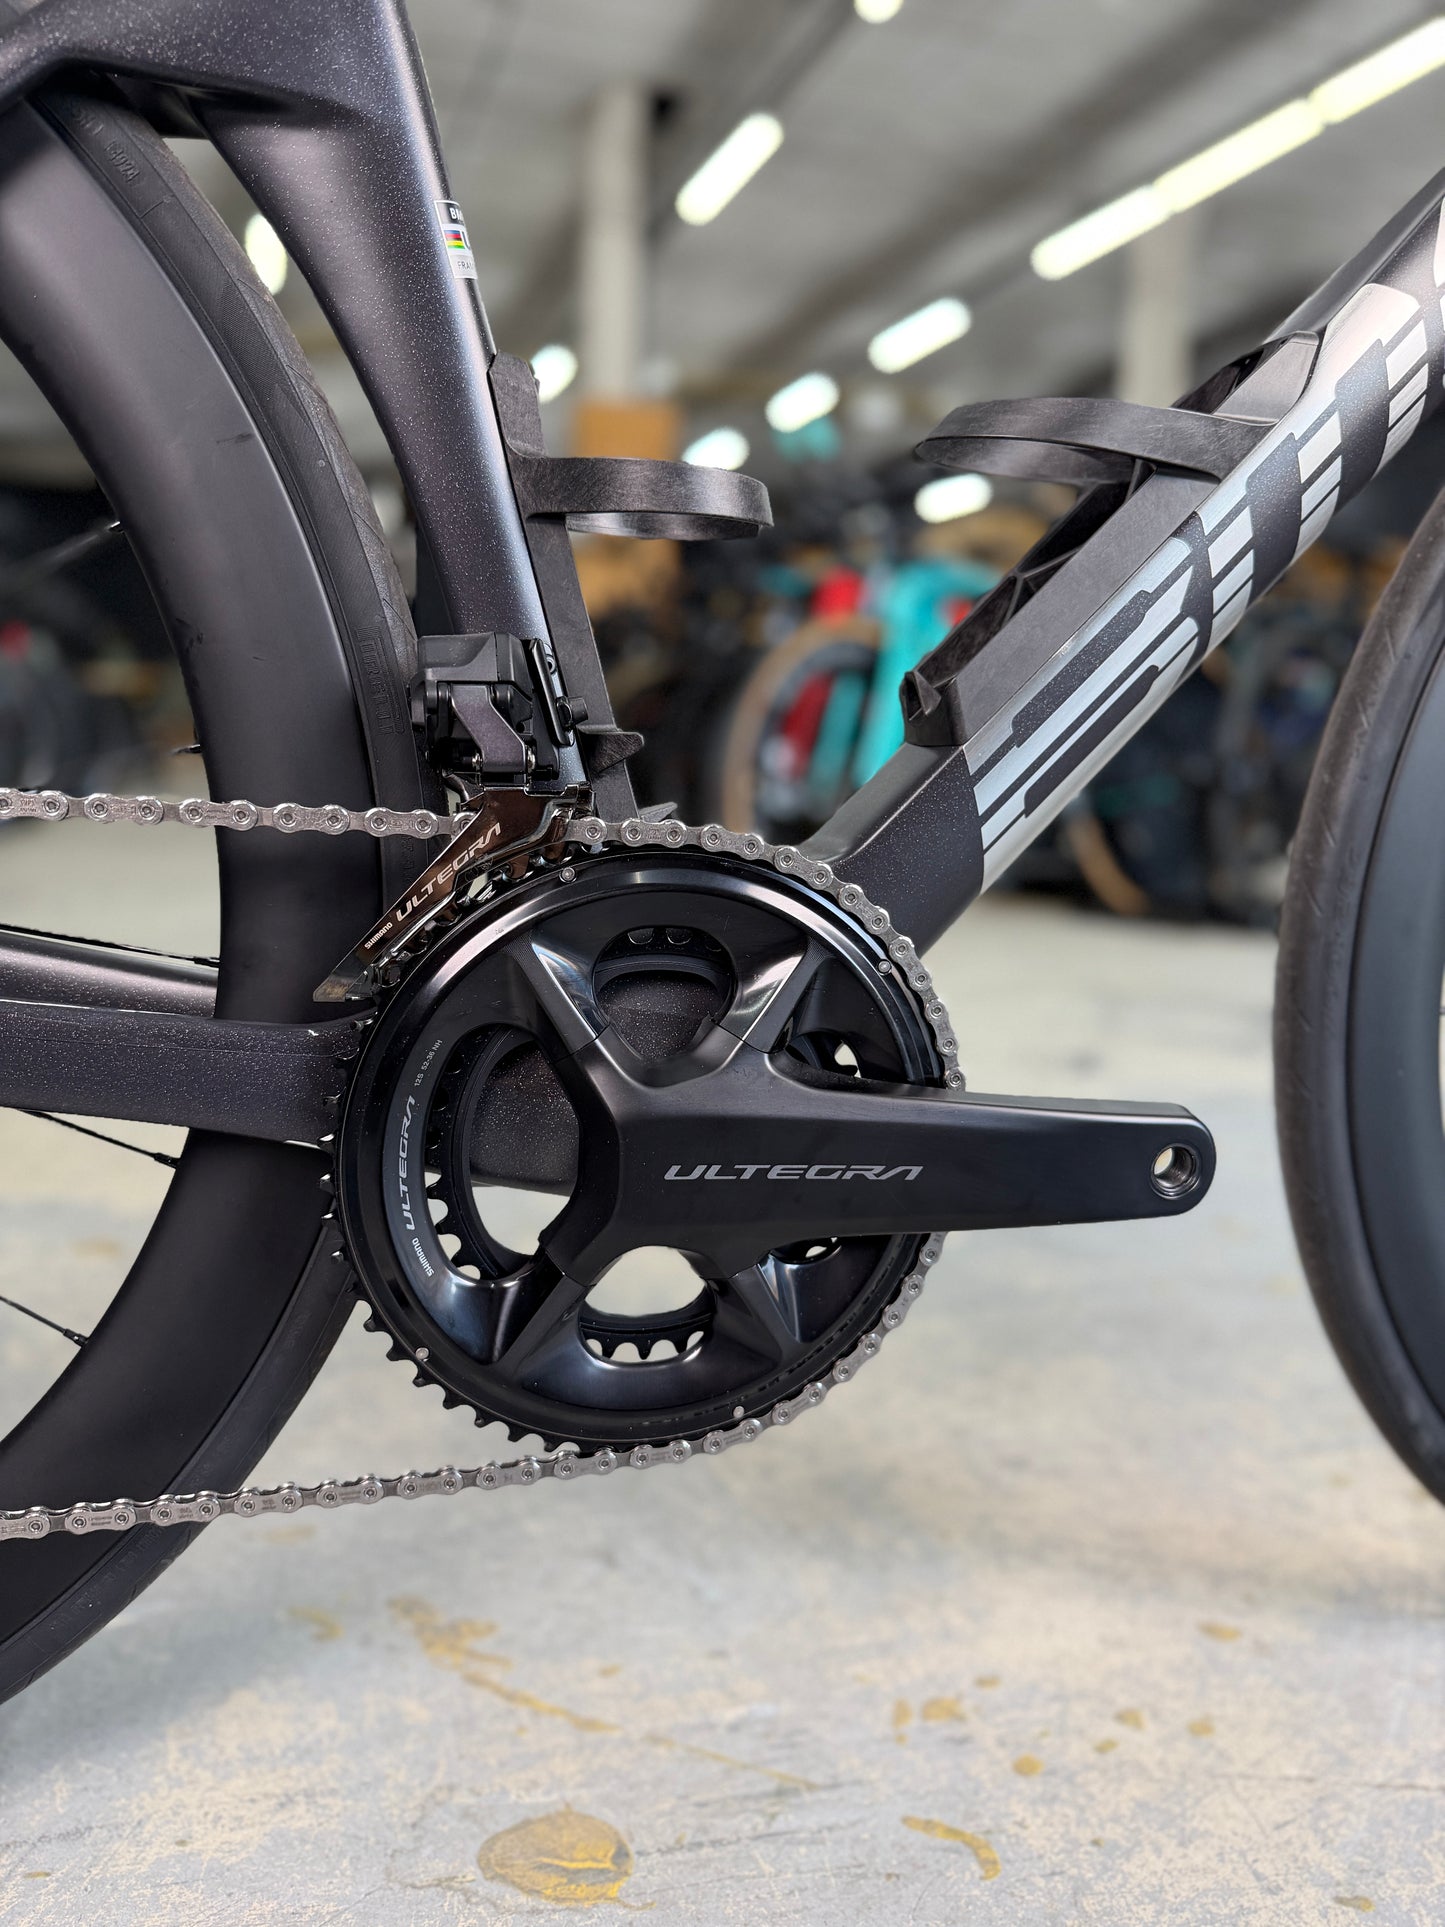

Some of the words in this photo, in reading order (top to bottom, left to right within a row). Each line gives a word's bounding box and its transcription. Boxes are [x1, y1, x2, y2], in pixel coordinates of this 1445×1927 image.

[364, 921, 393, 950] SHIMANO
[395, 822, 501, 922] ULTEGRA
[432, 1039, 443, 1051] NH
[421, 1051, 436, 1071] 52-36
[414, 1072, 424, 1086] 12S
[398, 1095, 416, 1231] ULTEGRA
[663, 1164, 924, 1181] ULTEGRA
[411, 1236, 435, 1278] SHIMANO
